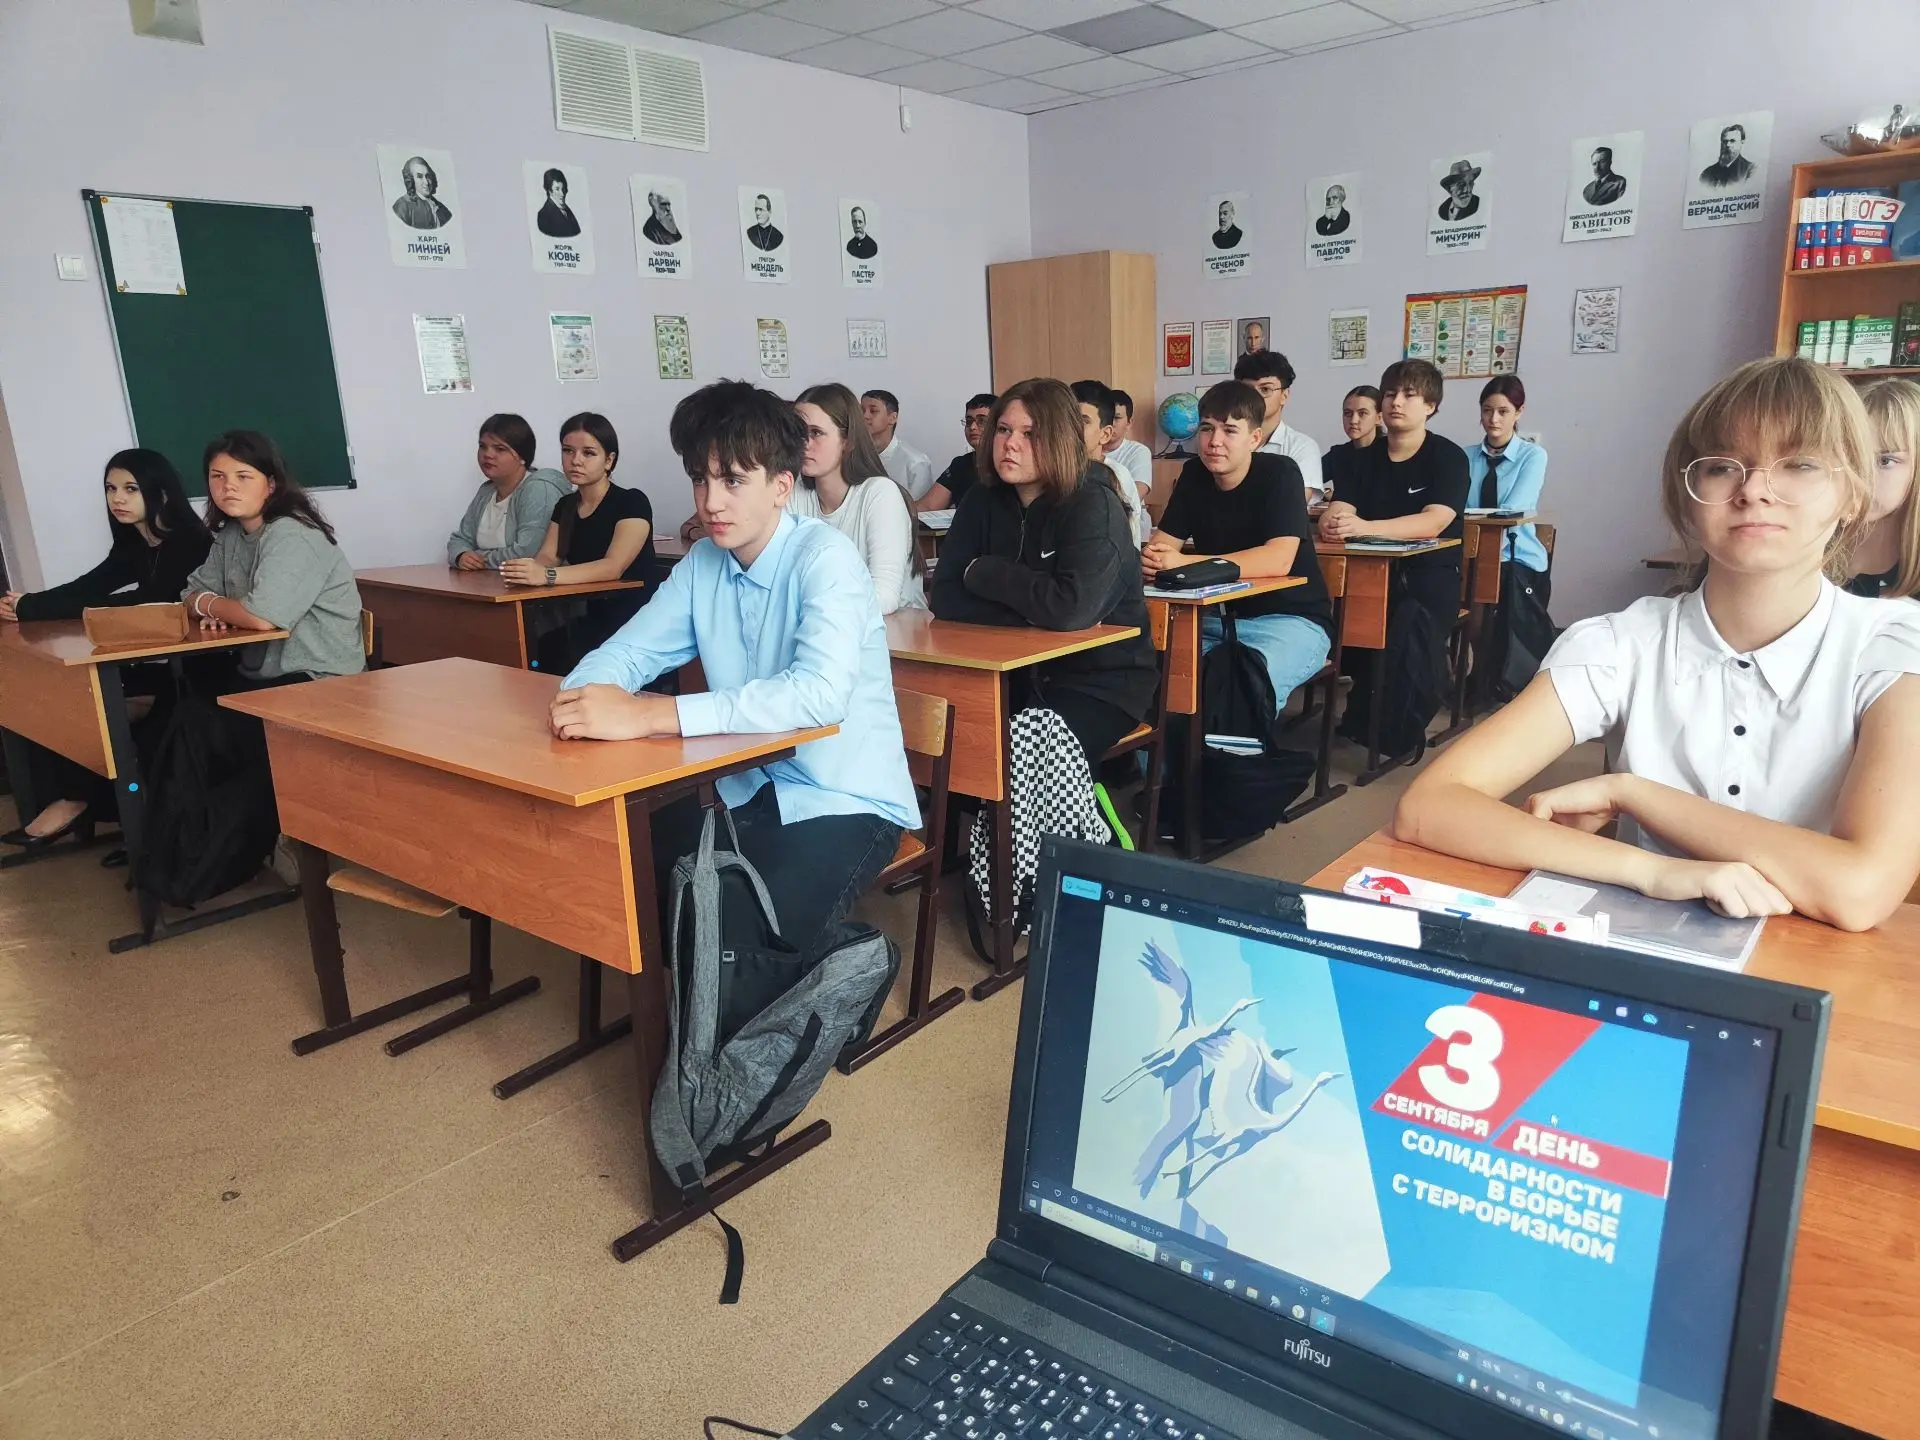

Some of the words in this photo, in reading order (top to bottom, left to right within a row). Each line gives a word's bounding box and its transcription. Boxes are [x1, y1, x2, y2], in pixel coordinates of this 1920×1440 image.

[1569, 211, 1598, 220] НИКОЛАЙ
[1599, 208, 1633, 217] ИВАНОВИЧ
[1687, 199, 1760, 217] ВЕРНАДСКИЙ
[1858, 199, 1900, 221] ОГЭ
[1572, 215, 1631, 230] ВАВИЛОВ
[418, 235, 438, 243] КАРЛ
[1327, 238, 1357, 247] ПЕТРОВИЧ
[1436, 231, 1481, 244] МИЧУРИН
[408, 242, 451, 255] ЛИННЕЙ
[1317, 246, 1351, 257] ПАВЛОВ
[548, 251, 581, 262] КЮВЬЕ
[648, 257, 681, 267] ДАРВИН
[751, 263, 784, 273] МЕНДЕЛЬ
[1211, 259, 1245, 270] СЕЧЕНОВ
[852, 270, 875, 278] ПАСТЕР
[1418, 1005, 1504, 1112] 3
[1383, 1092, 1490, 1137] СЕНТЯБРЯ
[1513, 1125, 1600, 1169] ДЕНЬ
[1401, 1129, 1623, 1215] СОЛИДАРНОСТИ
[1487, 1178, 1506, 1199] В
[1509, 1184, 1620, 1239] БОРЬБЕ
[1392, 1173, 1410, 1194] С
[1413, 1179, 1615, 1264] ТЕРРОРИЗМОМ
[1284, 1338, 1331, 1368] FUJITSU
